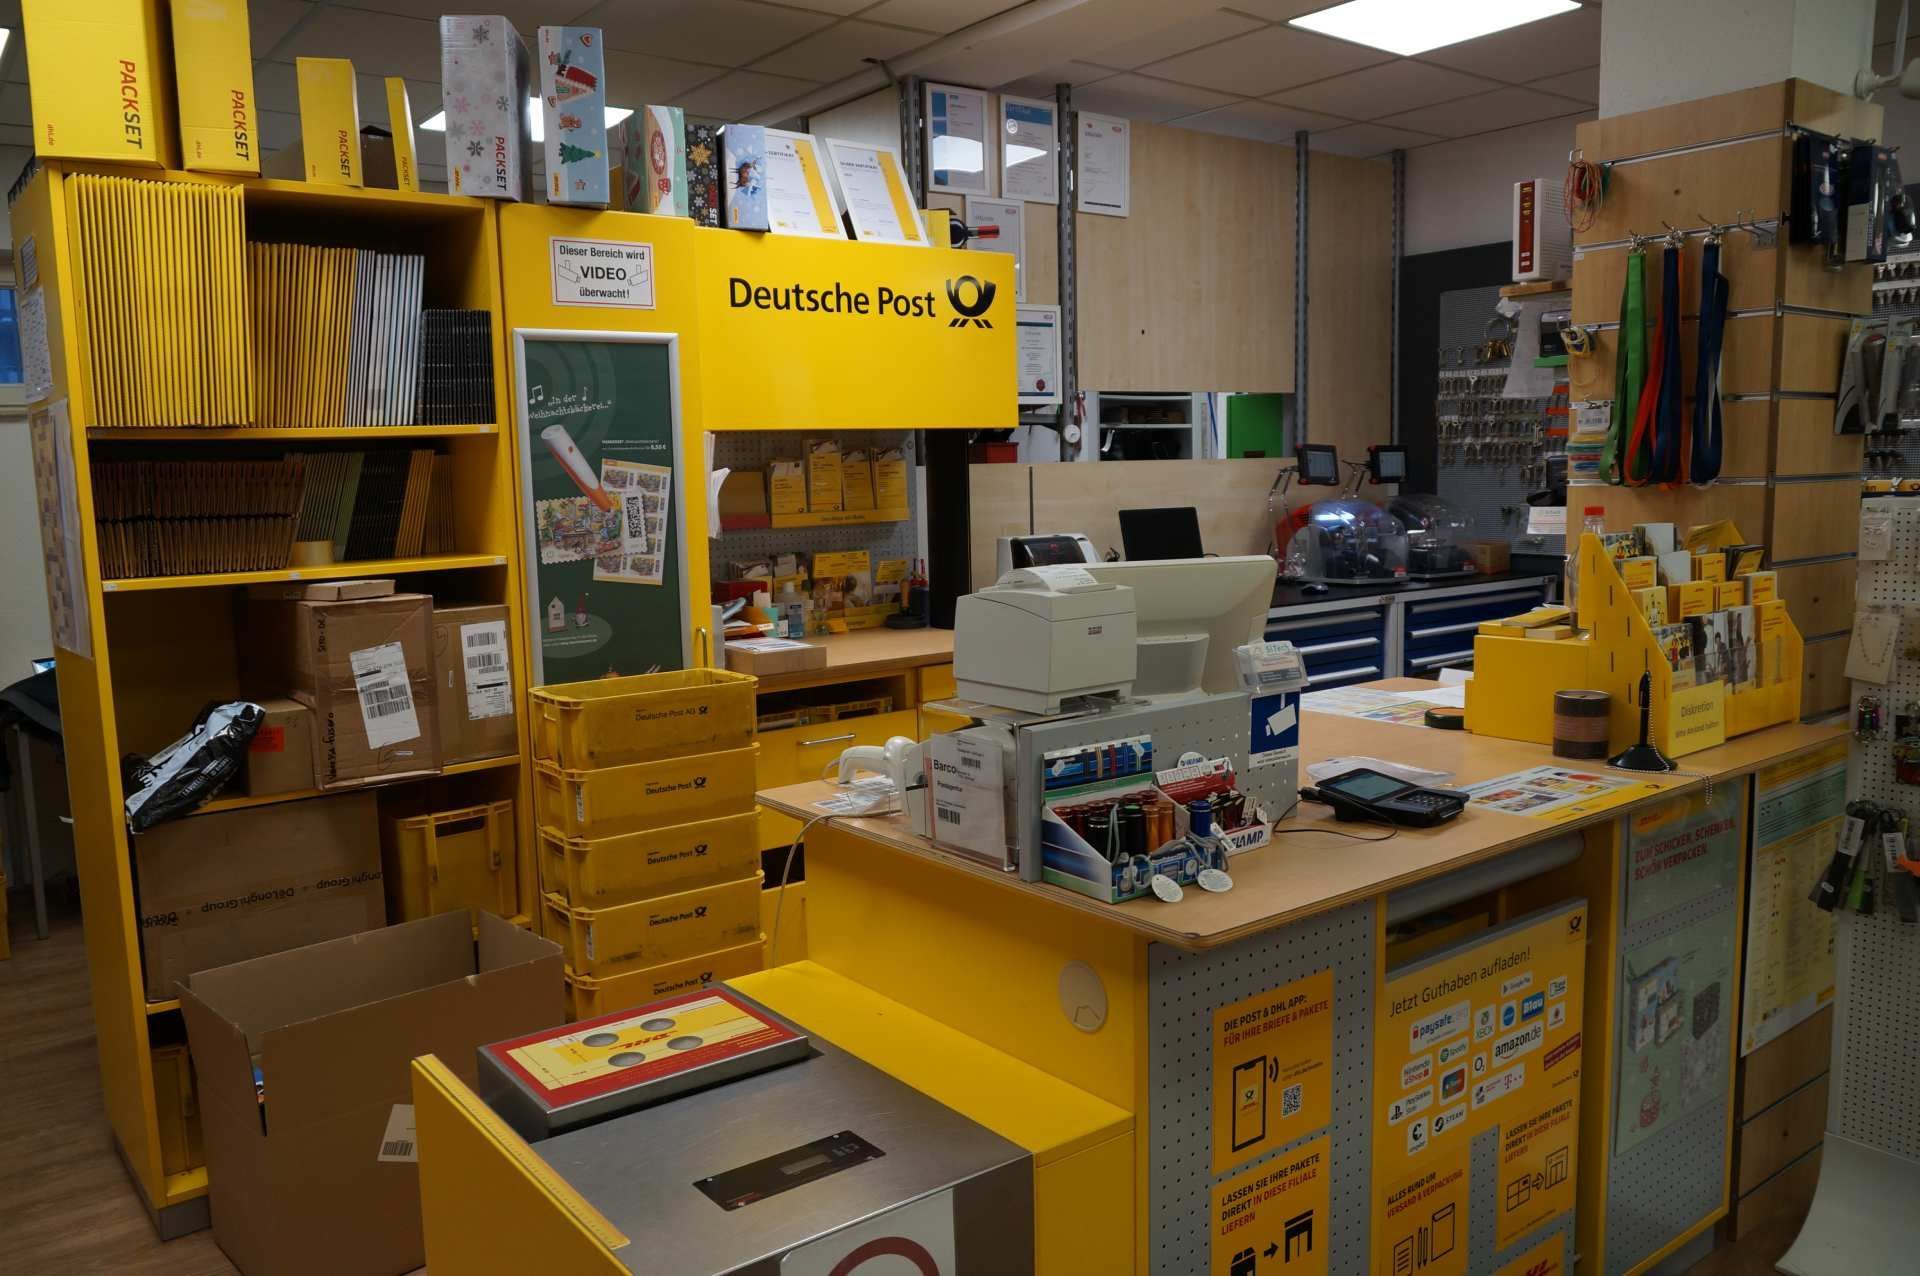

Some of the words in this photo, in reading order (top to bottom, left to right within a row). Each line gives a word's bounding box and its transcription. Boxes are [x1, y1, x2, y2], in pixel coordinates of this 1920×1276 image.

[119, 59, 143, 150] PACKSET
[231, 89, 249, 161] PACKSET
[338, 129, 351, 179] PACKSET
[495, 135, 507, 192] PACKSET
[559, 245, 588, 256] Dieser
[590, 247, 624, 259] Bereich
[625, 250, 645, 260] wird
[580, 265, 627, 280] VIDEO
[579, 286, 630, 299] überwacht!
[729, 277, 870, 315] Deutsche
[878, 286, 936, 318] Post
[635, 711, 668, 721] Deutsche
[669, 708, 684, 718] Post
[1681, 701, 1714, 718] Diskretion
[933, 759, 957, 774] Barco
[645, 784, 676, 795] Deutsche
[677, 781, 693, 791] Post
[647, 853, 677, 865] Deutsche
[679, 850, 693, 861] Post
[1635, 847, 1654, 863] ZUM
[1634, 860, 1662, 880] SCHÖN
[201, 896, 240, 914] Group
[240, 886, 296, 907] DeLonghi
[649, 915, 679, 926] Deutsche
[680, 911, 694, 922] Post
[653, 983, 683, 995] Deutsche
[684, 979, 699, 990] Post
[1390, 994, 1418, 1018] Jetzt
[1422, 969, 1478, 1003] Guthaben
[1480, 946, 1531, 980] aufladen!
[1224, 1018, 1239, 1032] DIE
[1240, 1009, 1262, 1026] POST
[1270, 1000, 1286, 1015] DHL
[1288, 994, 1307, 1009] APP:
[1224, 1032, 1241, 1048] FÜR
[1242, 1024, 1262, 1041] IHRE
[1263, 1014, 1290, 1032] BRIEFE
[1299, 999, 1329, 1018] PAKETE
[1494, 1025, 1542, 1058] amazon.de
[1505, 1121, 1528, 1140] LASSEN
[1551, 1099, 1573, 1116] PAKETE
[1505, 1134, 1526, 1152] DIREKT
[1222, 1183, 1254, 1206] LASSEN
[1255, 1177, 1269, 1190] SIE
[1270, 1168, 1289, 1184] IHRE
[1290, 1152, 1320, 1173] PAKETE
[1222, 1198, 1252, 1221] DIREKT
[1253, 1194, 1263, 1207] IN
[1264, 1182, 1287, 1200] DIESE
[1288, 1168, 1317, 1188] FILIALE
[1388, 1189, 1407, 1206] ALLES
[1408, 1178, 1425, 1194] RUND
[1387, 1195, 1417, 1219] VERSAND
[1221, 1211, 1256, 1235] LIEFERN
